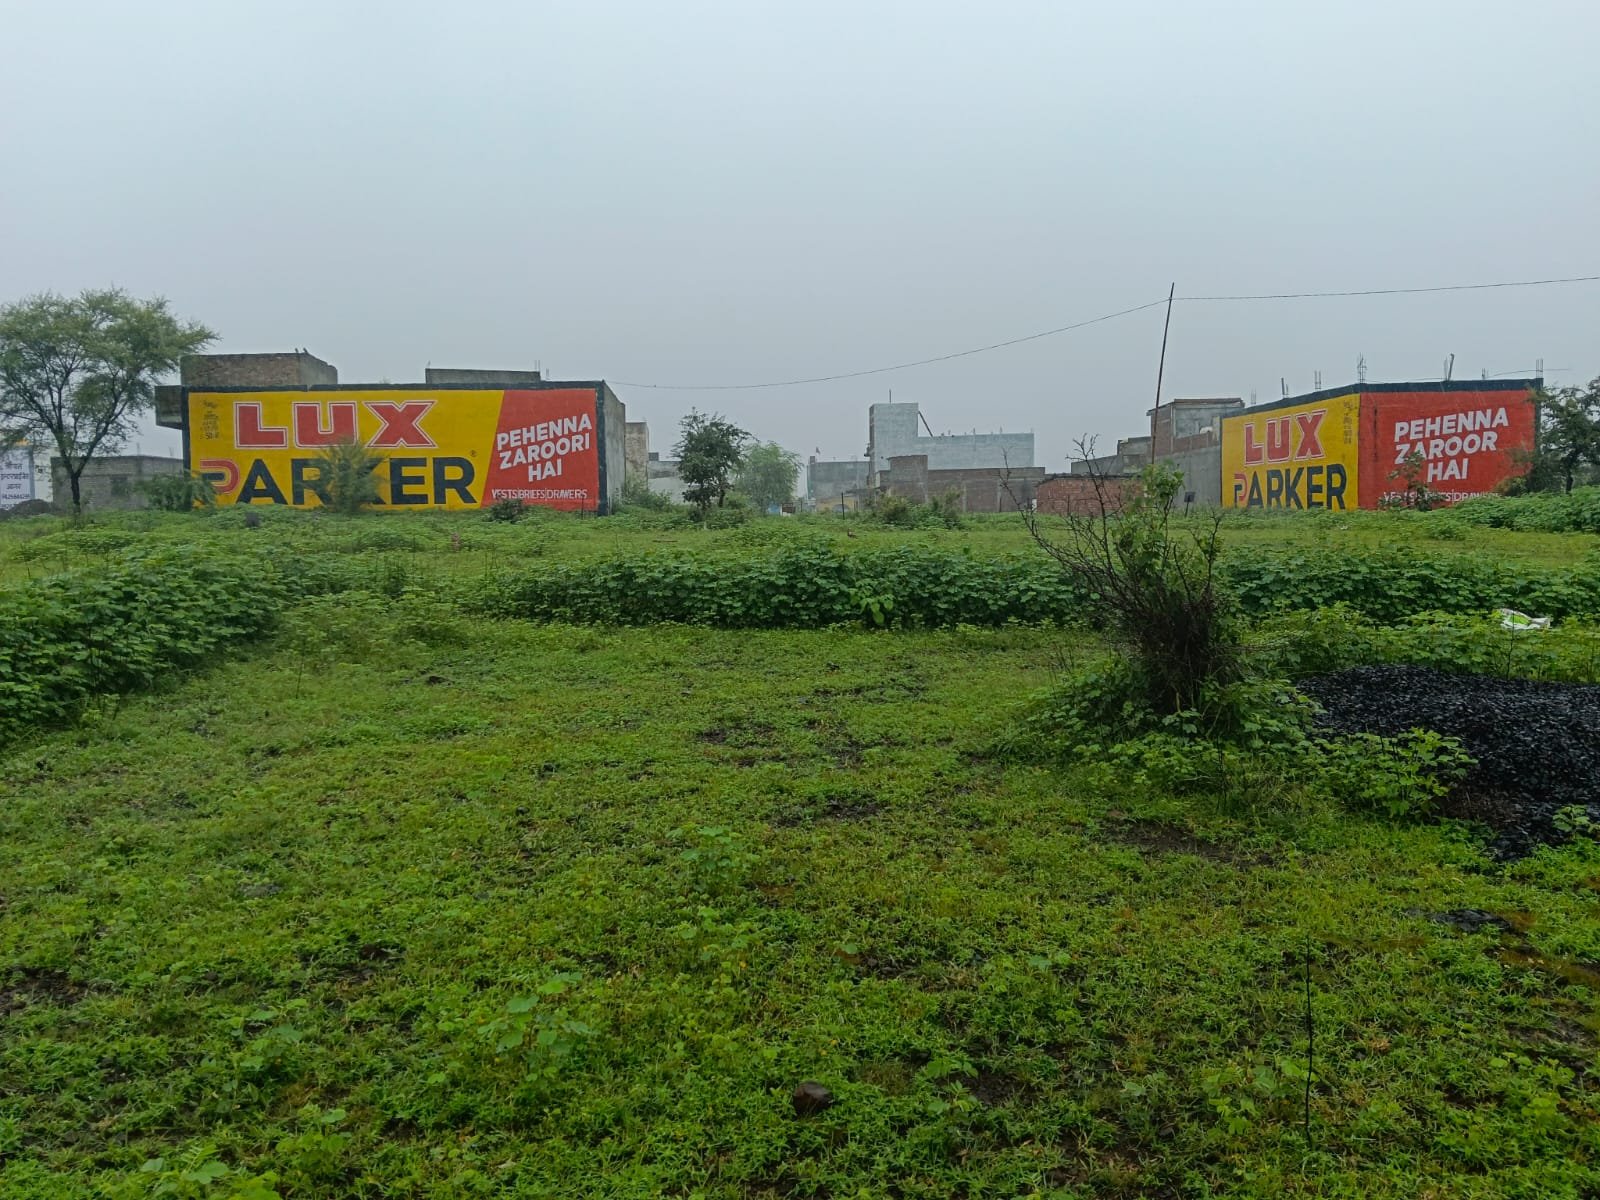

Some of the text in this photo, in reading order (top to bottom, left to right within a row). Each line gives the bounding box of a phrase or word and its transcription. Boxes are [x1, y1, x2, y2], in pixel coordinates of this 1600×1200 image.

[234, 400, 439, 449] LUX
[496, 413, 592, 451] PEHENNA
[1244, 409, 1327, 466] LUX
[1394, 407, 1509, 443] PEHENNA
[499, 432, 590, 470] ZAROORI
[1394, 431, 1498, 465] ZAROOR
[528, 458, 562, 482] HAI
[1234, 463, 1347, 509] PARKER
[1427, 458, 1469, 483] HAI
